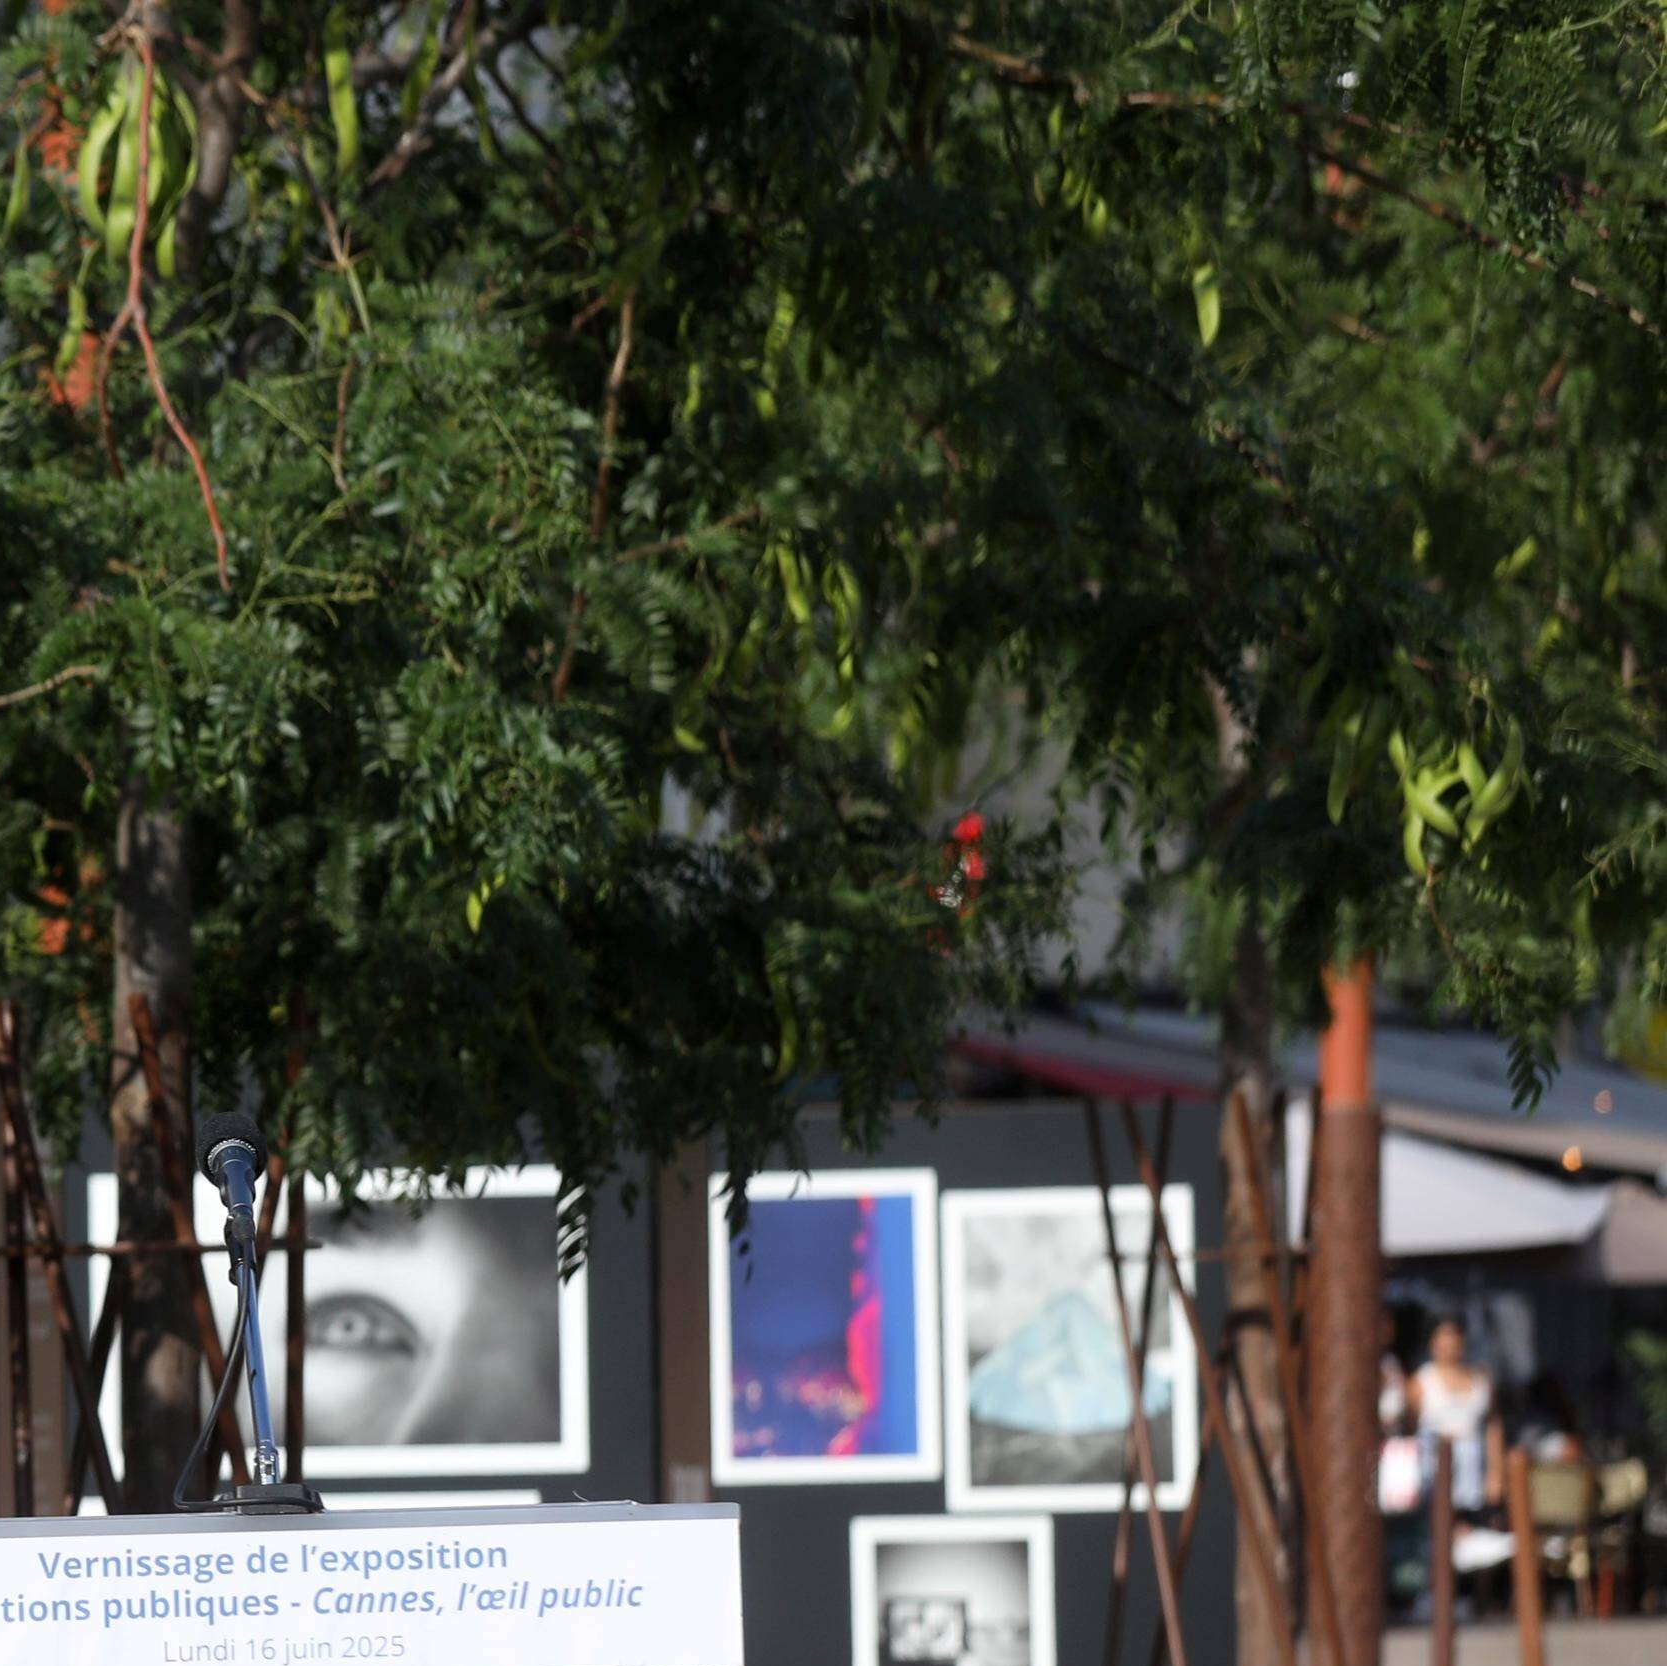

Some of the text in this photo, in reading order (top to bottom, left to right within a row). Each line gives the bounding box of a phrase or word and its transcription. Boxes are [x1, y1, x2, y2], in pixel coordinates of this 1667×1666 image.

[37, 1540, 508, 1584] Vernissage de l'exposition
[103, 1589, 280, 1628] publiques
[313, 1586, 444, 1616] Cannes,
[456, 1580, 530, 1612] l'œil
[537, 1578, 644, 1618] public
[163, 1635, 405, 1666] Lundi 16 juin 2025
